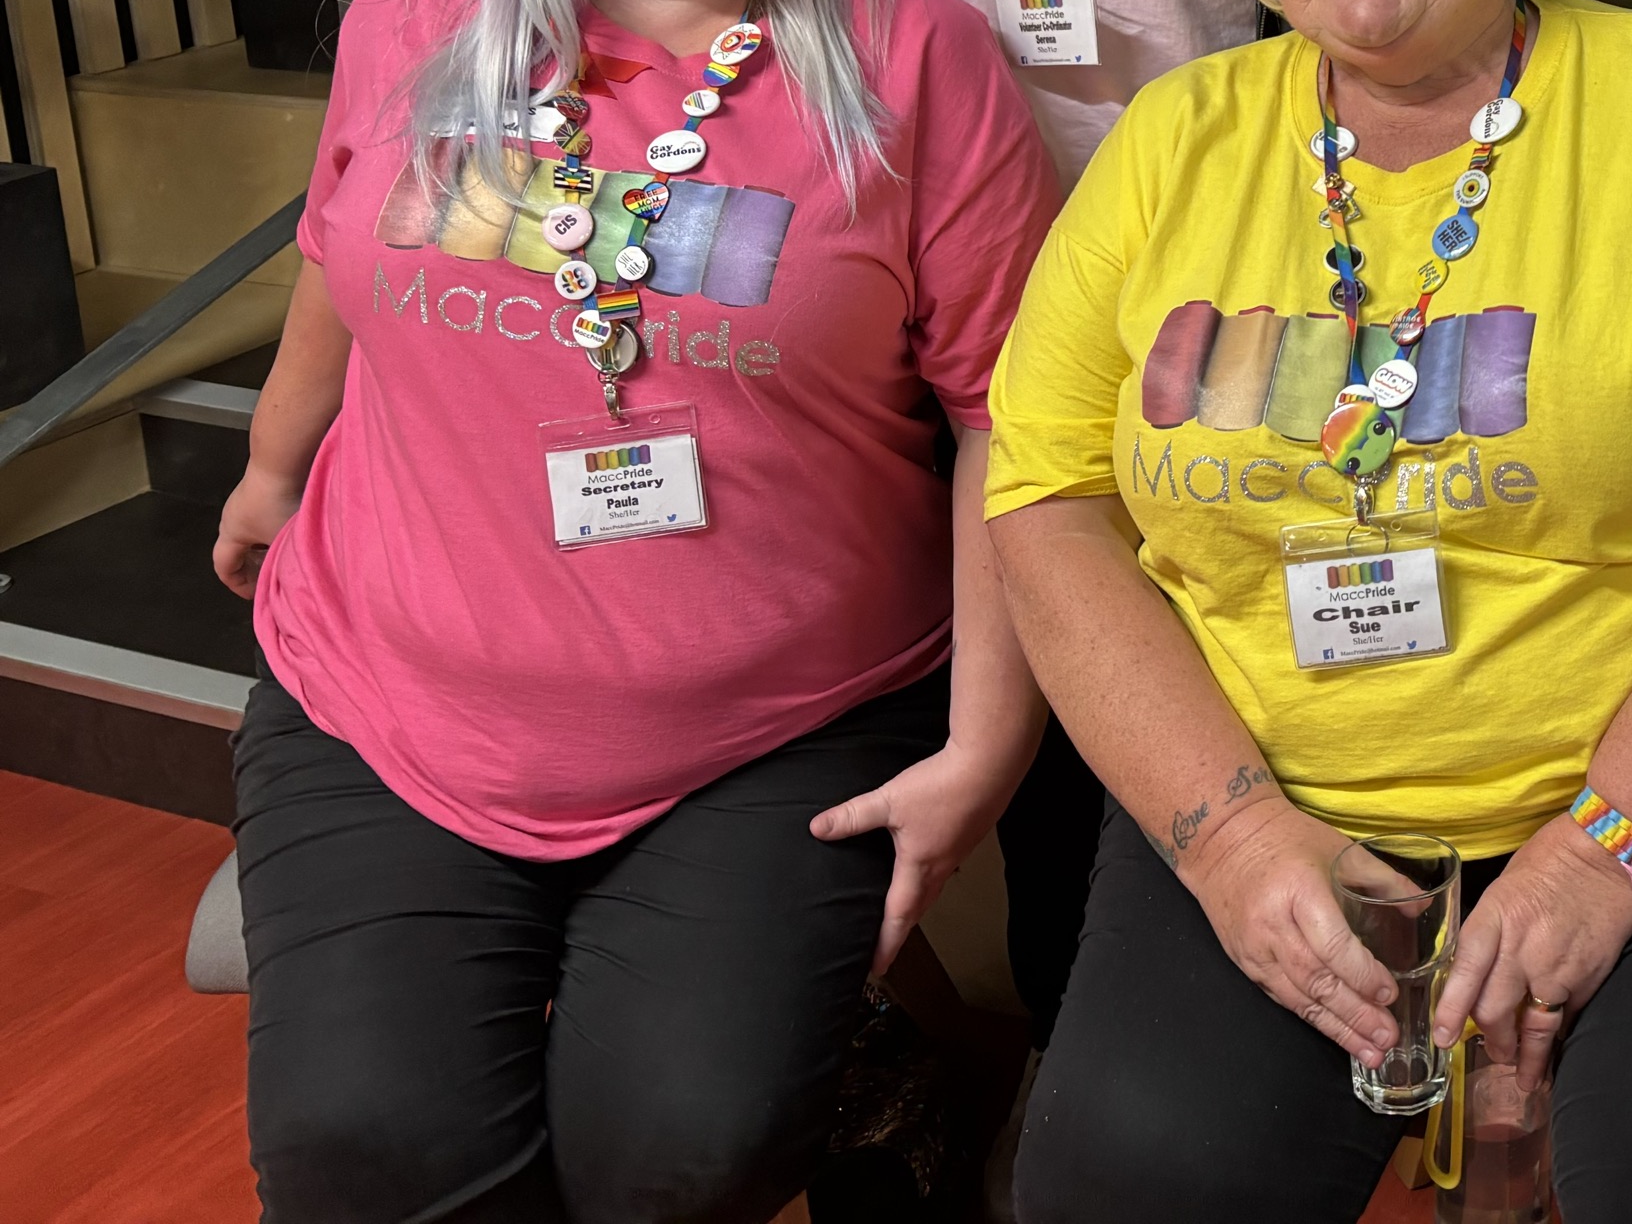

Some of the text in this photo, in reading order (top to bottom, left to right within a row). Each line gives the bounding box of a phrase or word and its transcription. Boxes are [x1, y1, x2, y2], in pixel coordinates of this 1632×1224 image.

[1035, 35, 1057, 44] Serena
[650, 144, 673, 154] Gay
[650, 147, 702, 160] Gordons
[633, 188, 658, 201] FREE
[554, 214, 578, 236] CIS
[1436, 229, 1459, 253] HER
[373, 260, 782, 377] Maccride
[587, 467, 653, 485] MaccPride
[1132, 433, 1540, 512] Maccride
[581, 477, 664, 497] Secretary
[606, 495, 639, 509] Paula
[608, 509, 640, 520] She/Her
[1328, 585, 1396, 603] MaccPride
[1312, 599, 1421, 623] Chair
[1348, 620, 1382, 635] Sue
[1352, 635, 1384, 646] She/Her
